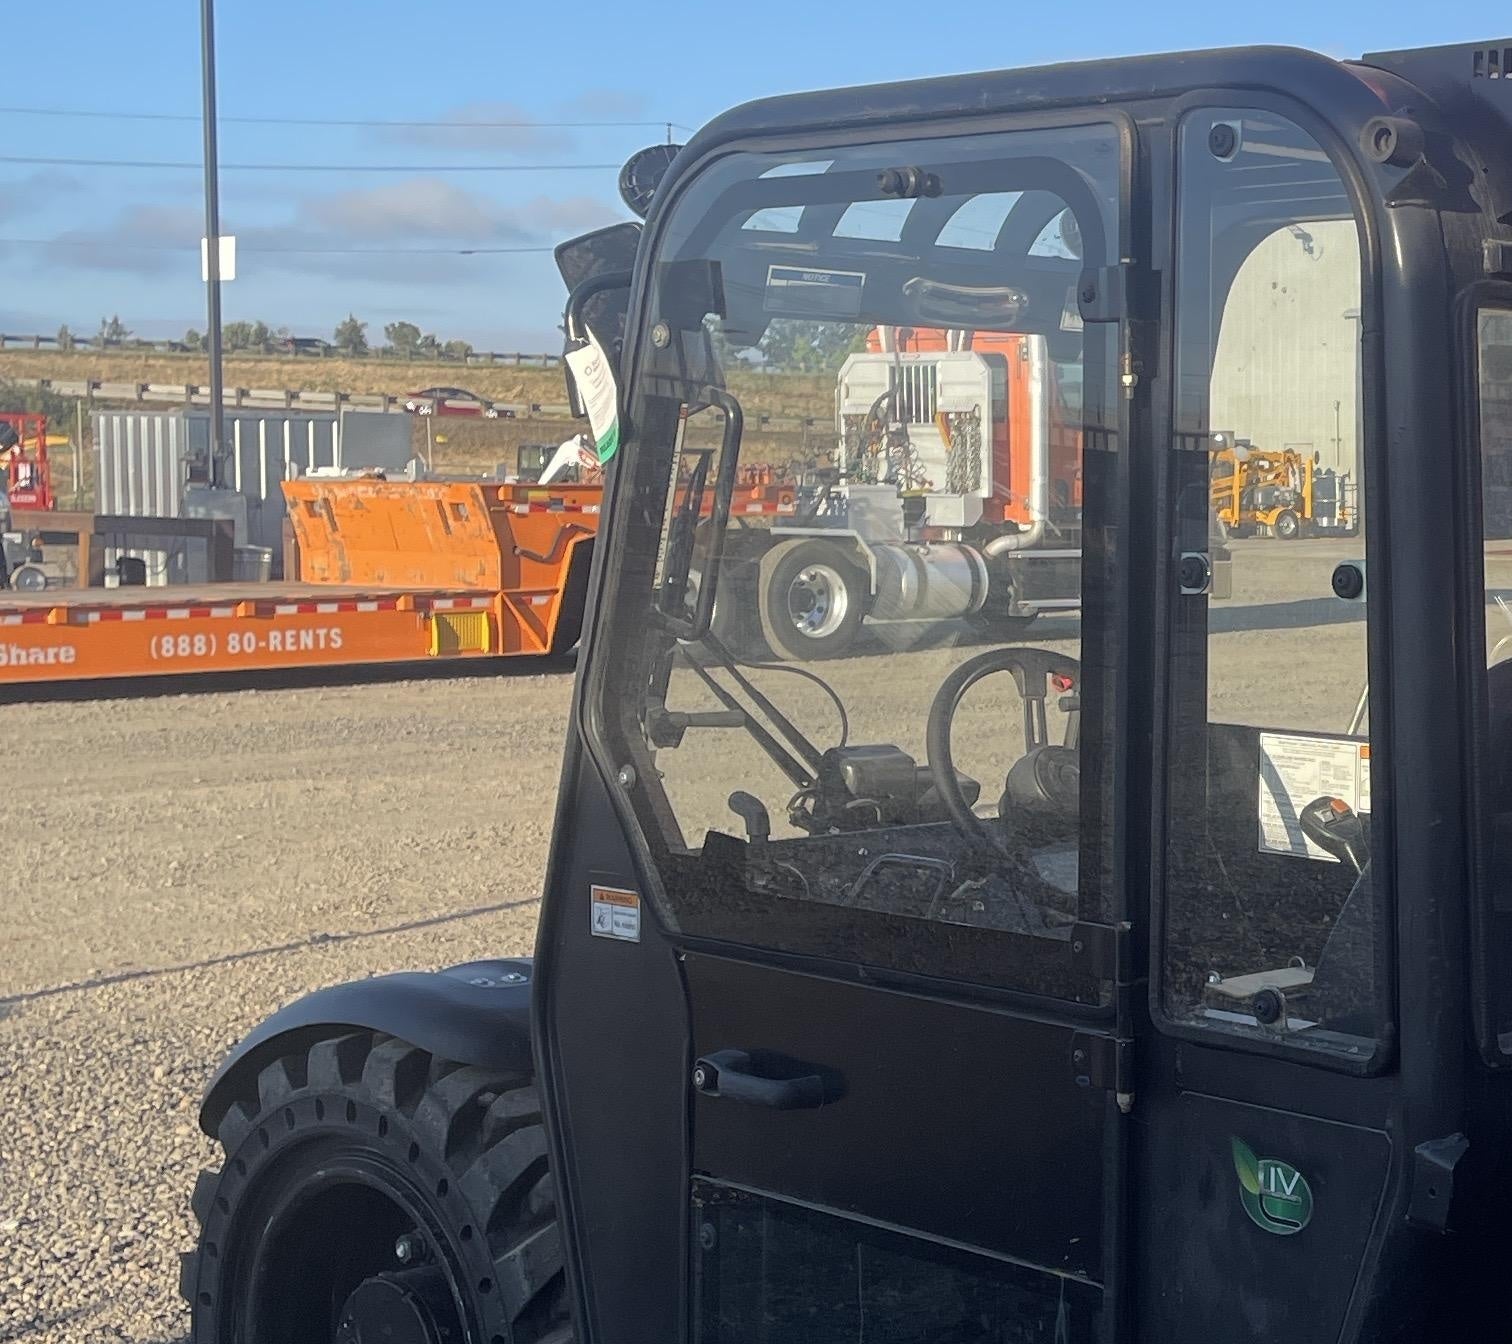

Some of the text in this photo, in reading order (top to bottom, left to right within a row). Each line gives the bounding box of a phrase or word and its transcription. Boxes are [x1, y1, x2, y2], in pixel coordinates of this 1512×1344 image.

[801, 272, 832, 283] NOTICE
[150, 635, 218, 659] (888)
[227, 627, 342, 655] 80-RENTS
